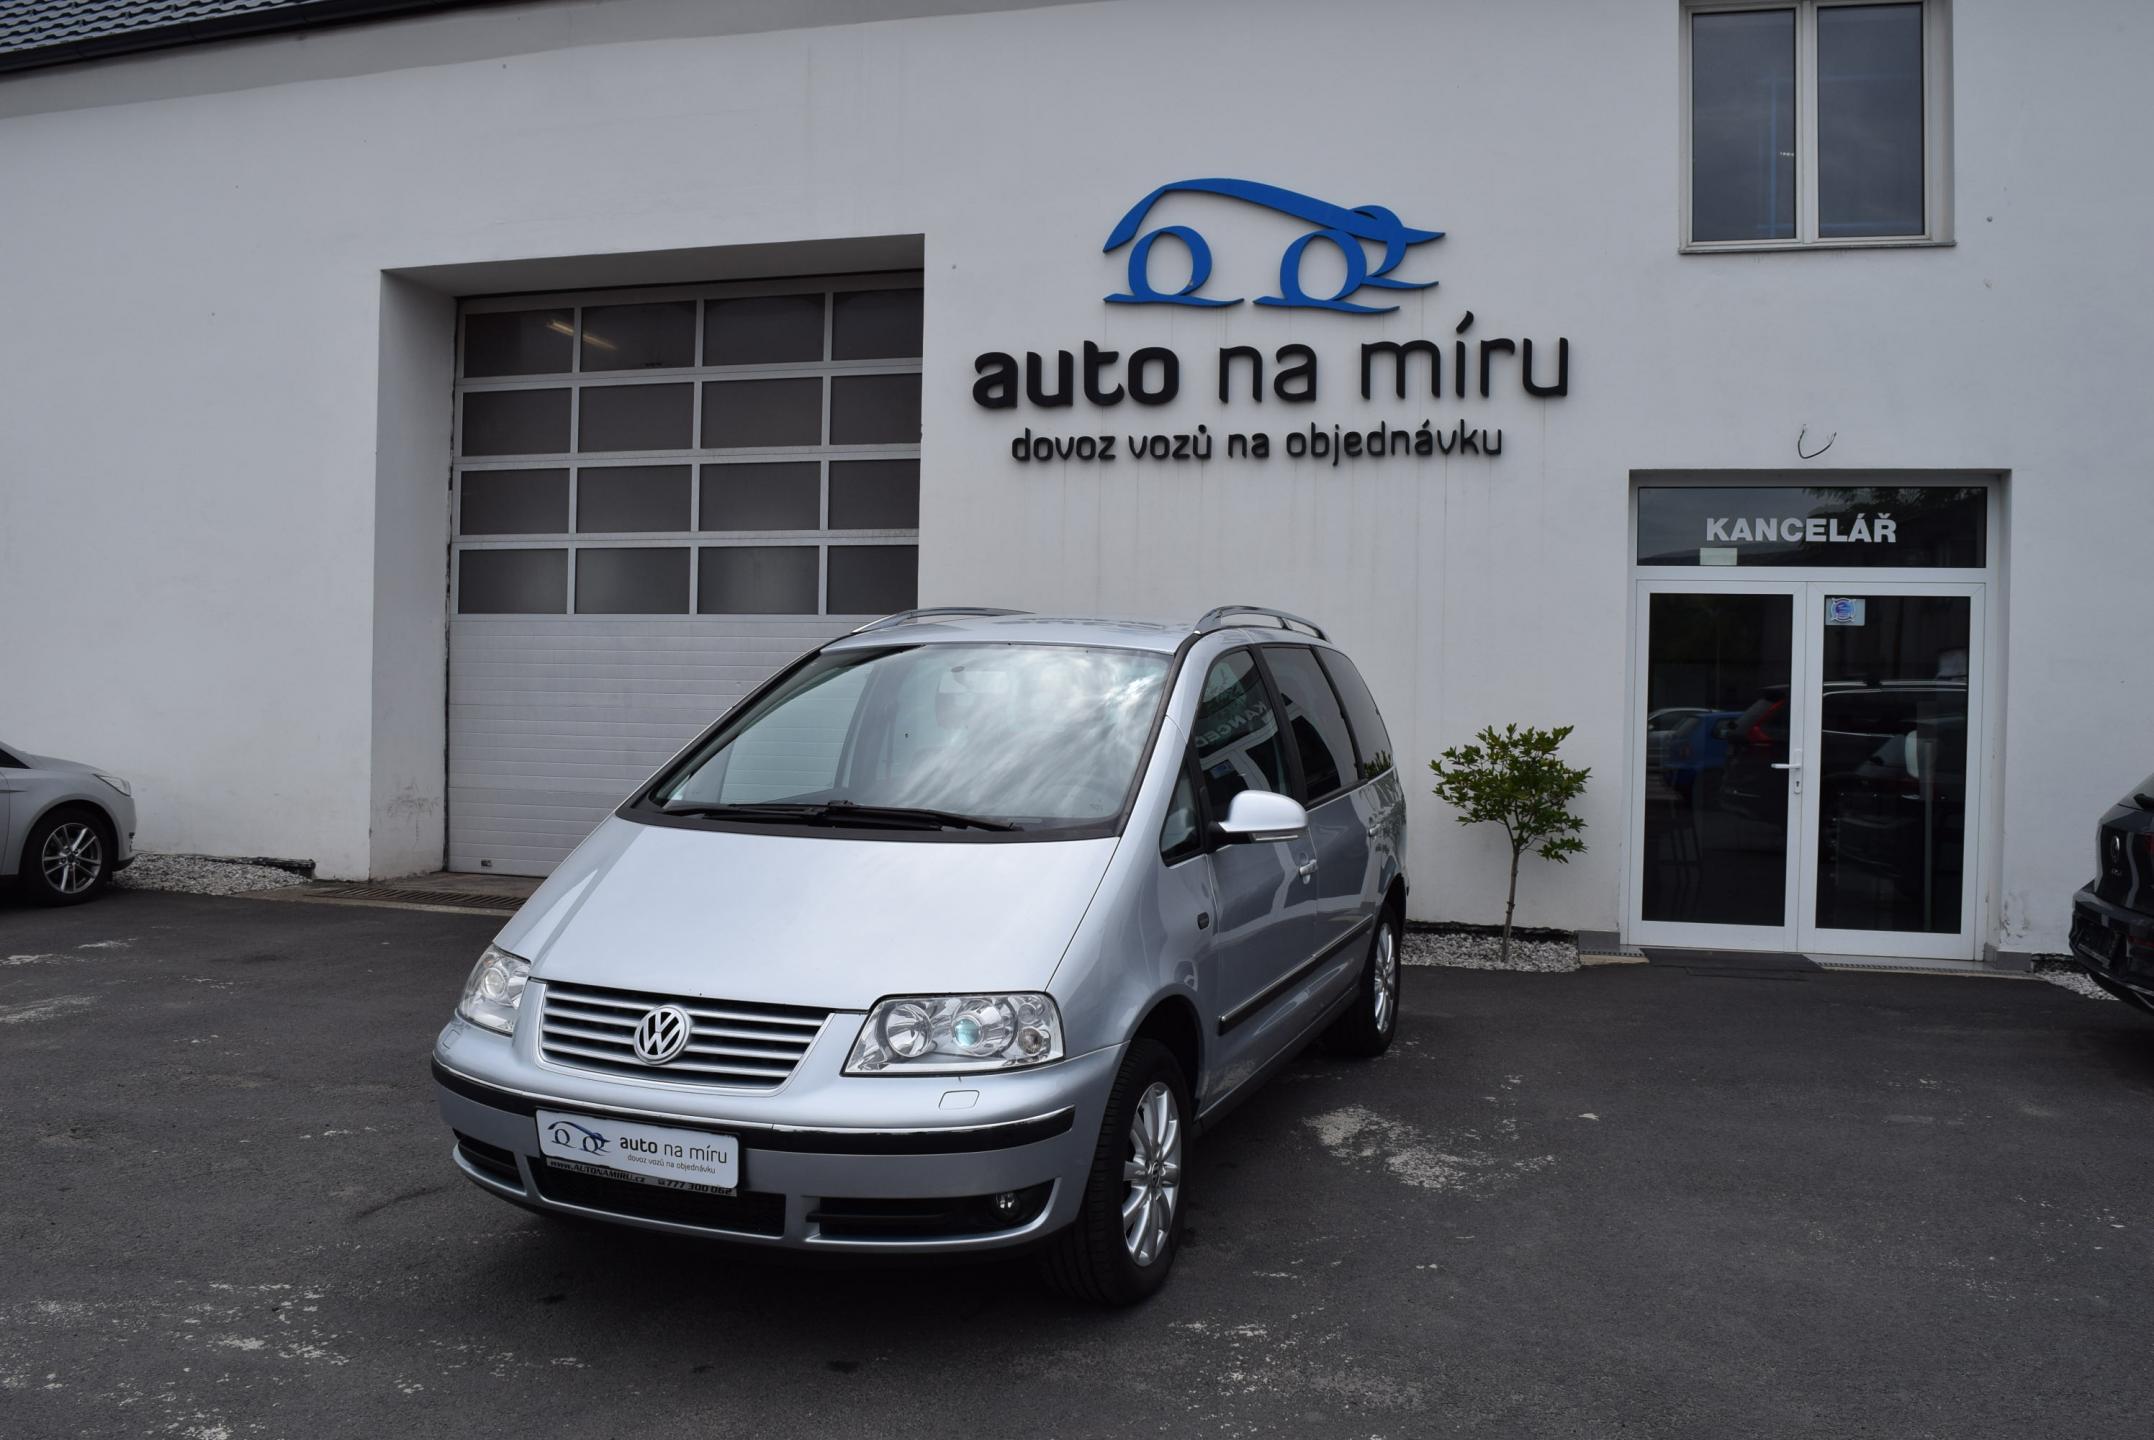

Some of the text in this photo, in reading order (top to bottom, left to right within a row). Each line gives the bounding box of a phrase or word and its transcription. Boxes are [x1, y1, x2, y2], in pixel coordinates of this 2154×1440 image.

[972, 310, 1569, 411] auto na míru
[1011, 418, 1503, 468] dovoz vozů na objednávku
[1706, 512, 1897, 543] KANCELÁŘ
[619, 1136, 728, 1165] auto na míru
[627, 1154, 647, 1165] dovoz
[666, 1160, 675, 1169] na
[676, 1161, 716, 1175] objednávku
